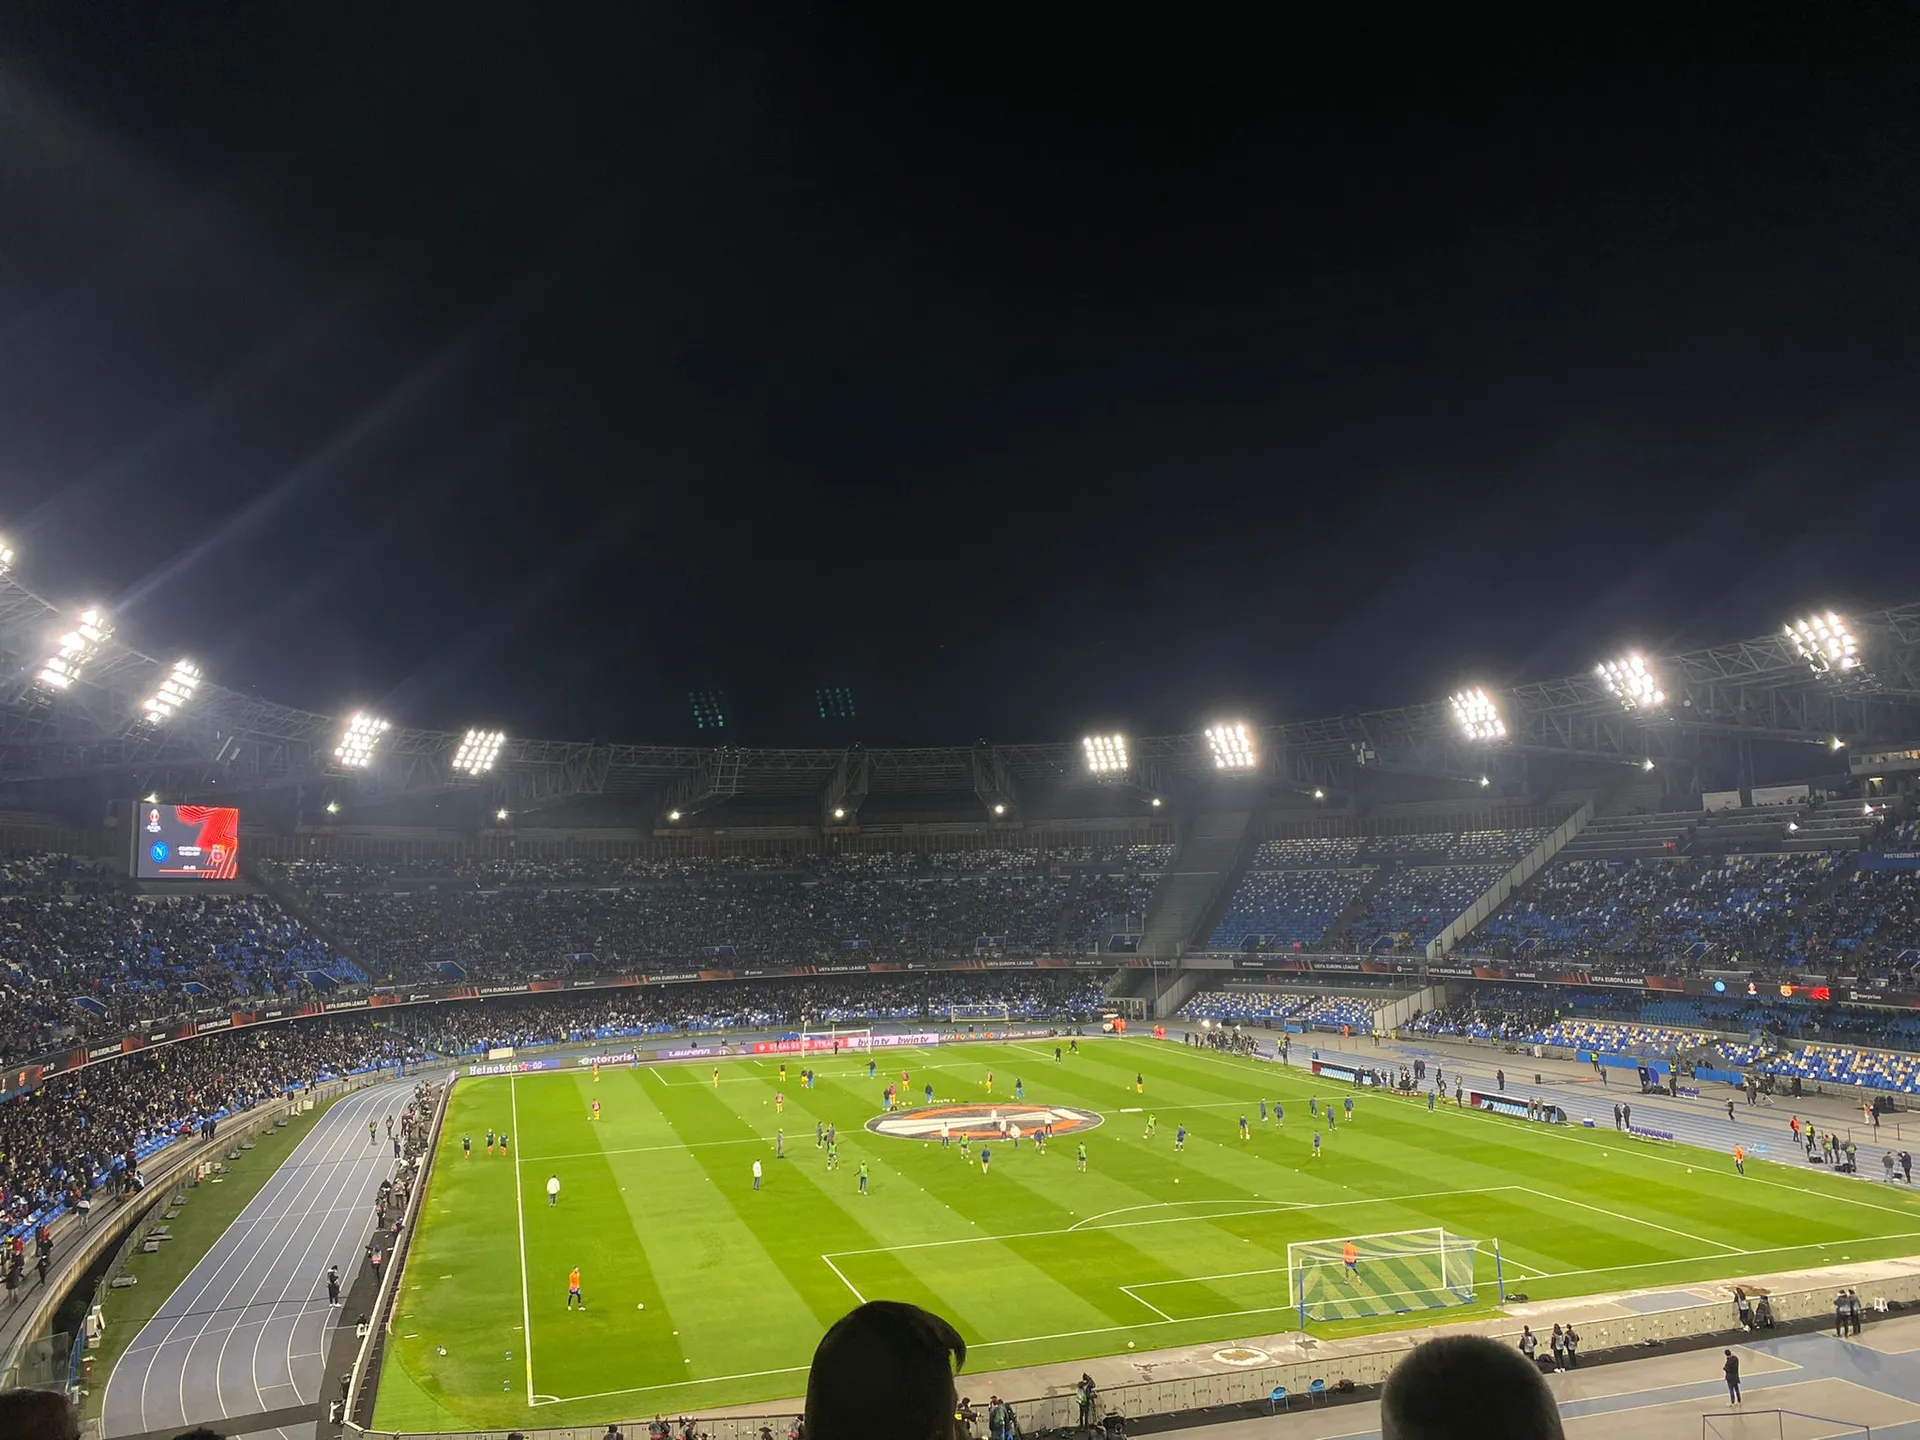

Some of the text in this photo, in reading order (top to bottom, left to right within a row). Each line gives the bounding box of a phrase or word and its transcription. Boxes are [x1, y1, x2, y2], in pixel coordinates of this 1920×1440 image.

[1605, 976, 1624, 984] EUROPA
[1624, 977, 1644, 985] LEAGUE
[881, 1037, 890, 1045] tv
[897, 1035, 929, 1044] bwin tv
[469, 1063, 518, 1076] Heineken
